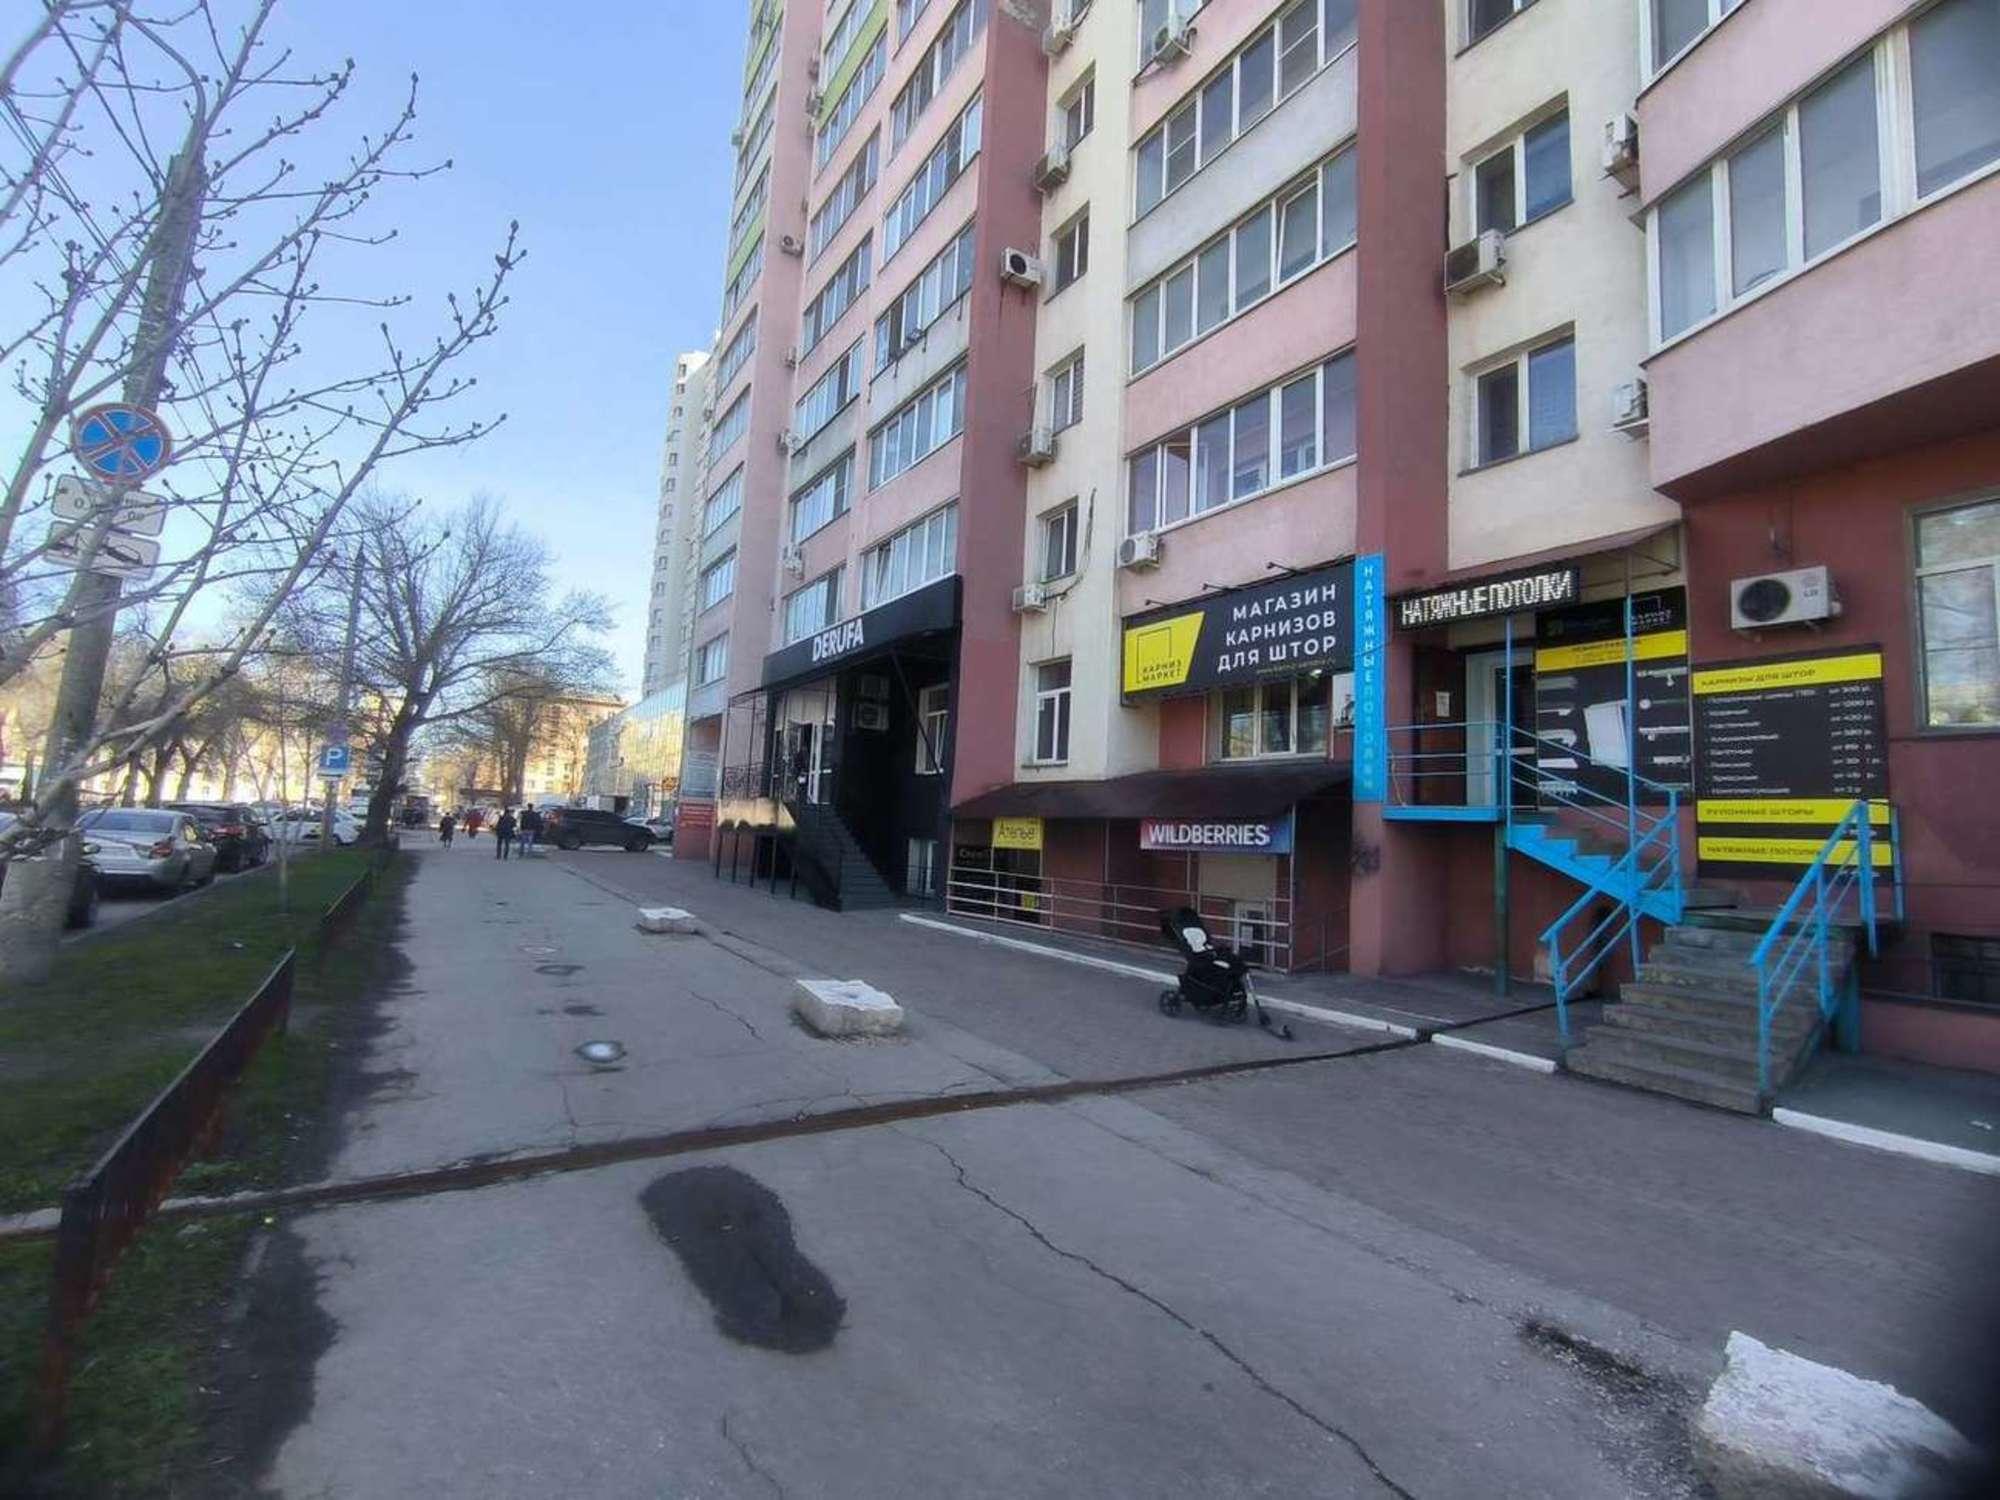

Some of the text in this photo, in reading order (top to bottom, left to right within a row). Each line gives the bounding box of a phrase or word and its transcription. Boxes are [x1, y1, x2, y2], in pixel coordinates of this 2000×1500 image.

[1232, 583, 1337, 623] МАГАЗИН
[1401, 570, 1573, 626] НАТЯЖНЫЕ ПОТОЛКИ
[811, 618, 865, 663] DERUFA
[1225, 610, 1337, 647] КАРНИЗОВ
[1362, 566, 1375, 682] НАТЯЖНЫЕ
[1216, 650, 1261, 675] ДЛЯ
[1268, 635, 1337, 662] ШТОР
[326, 748, 343, 766] P
[1149, 824, 1272, 846] WILDBERRIES
